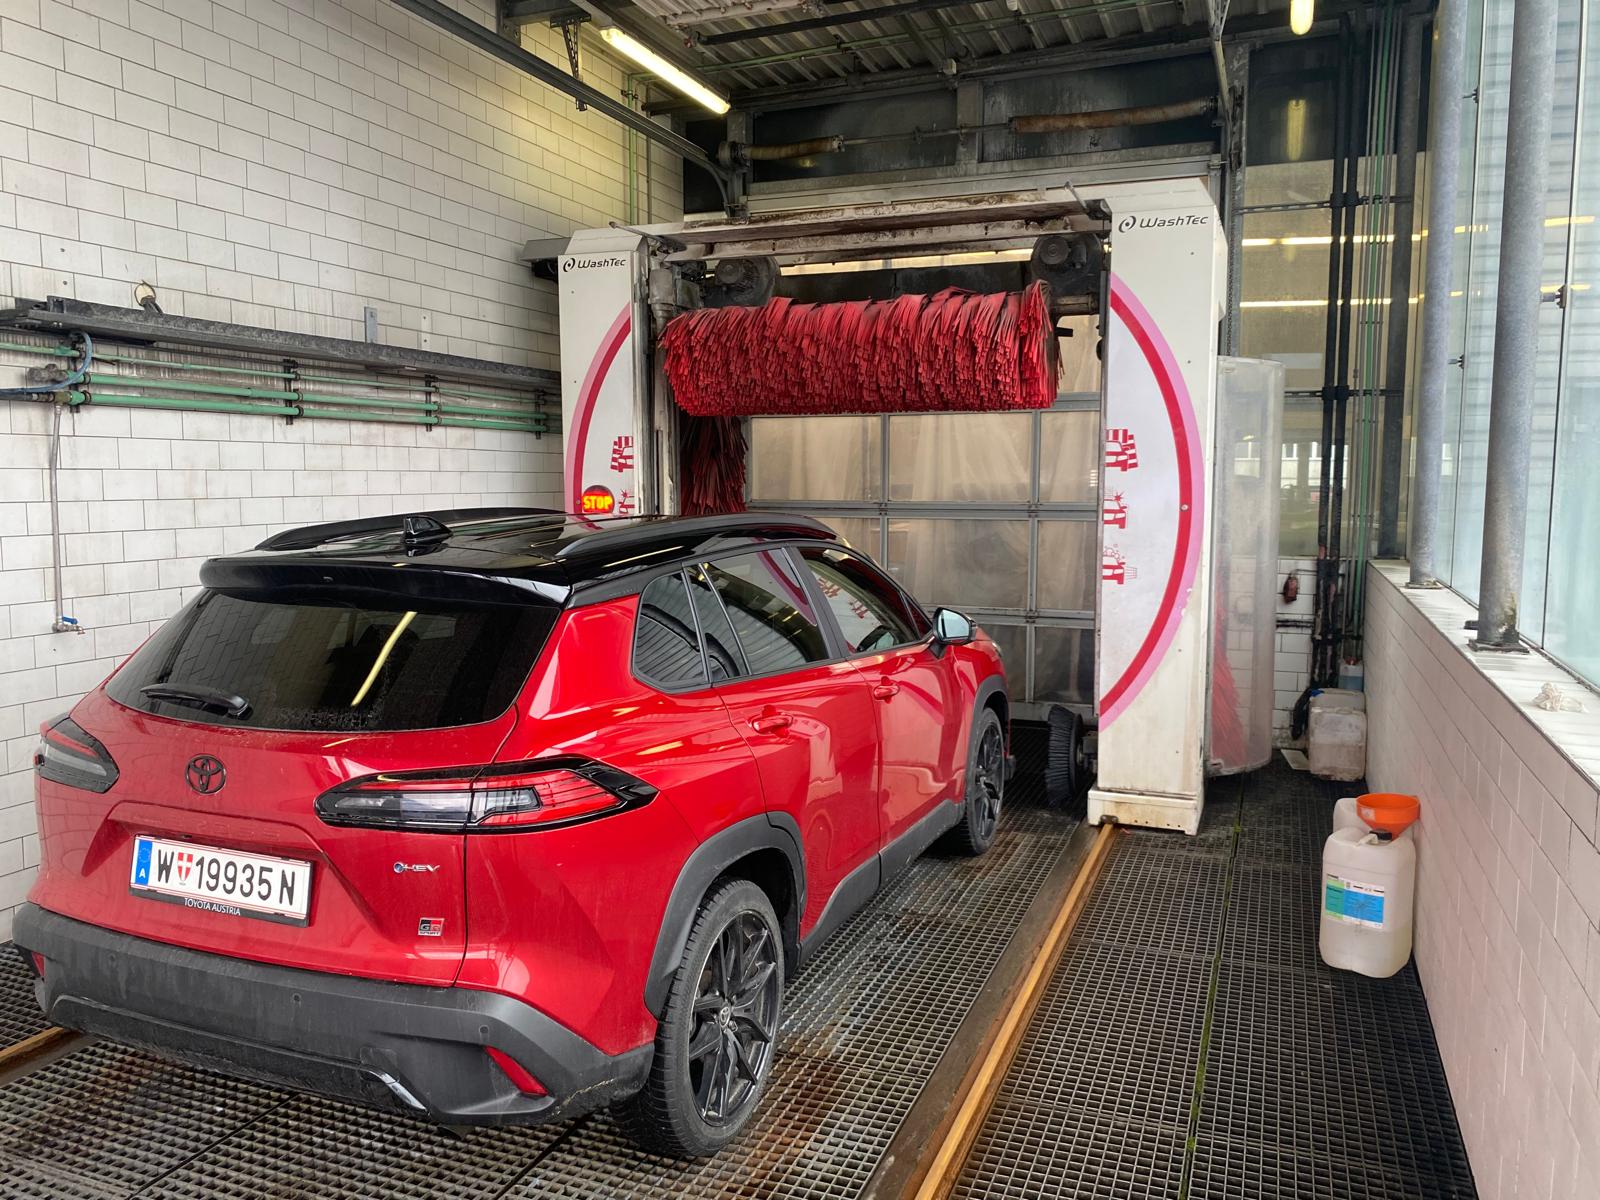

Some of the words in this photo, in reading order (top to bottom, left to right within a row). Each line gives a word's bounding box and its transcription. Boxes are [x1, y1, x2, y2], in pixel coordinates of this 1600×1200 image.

[1140, 215, 1208, 228] WashTec
[578, 258, 626, 268] WashTec
[583, 495, 612, 509] STOP
[138, 868, 146, 879] A
[158, 849, 174, 884] W
[195, 856, 273, 901] 19935
[279, 869, 295, 906] N
[184, 897, 211, 911] TOYOTA
[211, 903, 241, 916] AUSTRIA
